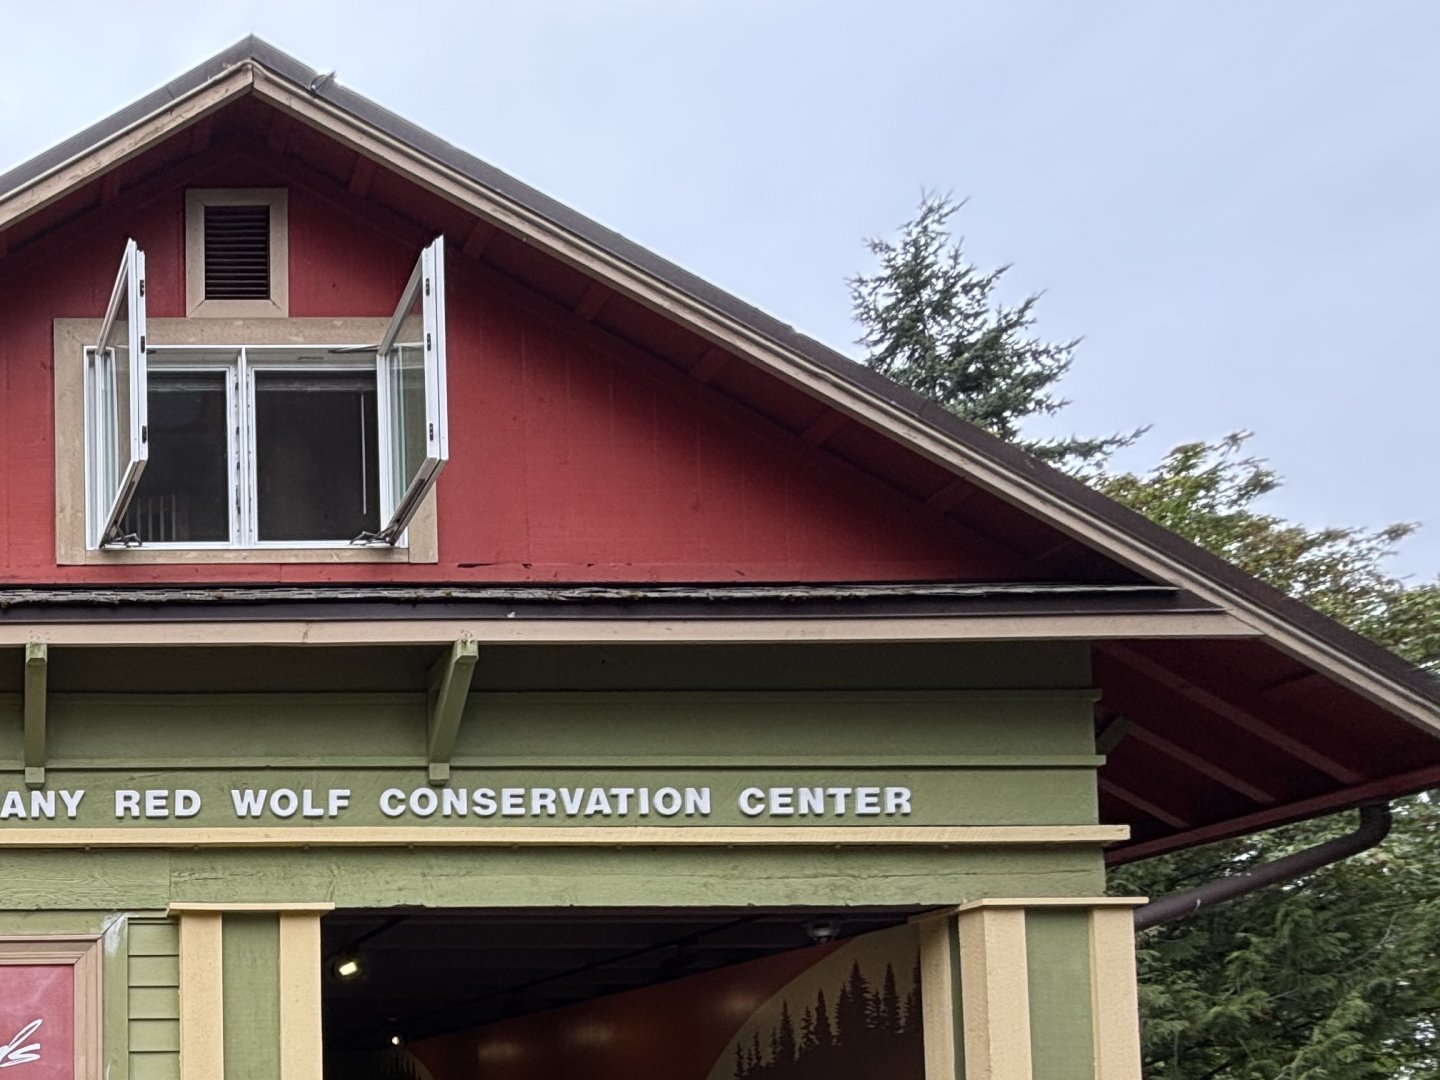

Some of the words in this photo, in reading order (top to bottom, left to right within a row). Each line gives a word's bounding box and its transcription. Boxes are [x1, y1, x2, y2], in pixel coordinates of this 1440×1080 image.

[114, 789, 202, 818] RED
[231, 788, 351, 817] WOLF
[378, 787, 712, 816] CONSERVATION
[737, 787, 913, 815] CENTER
